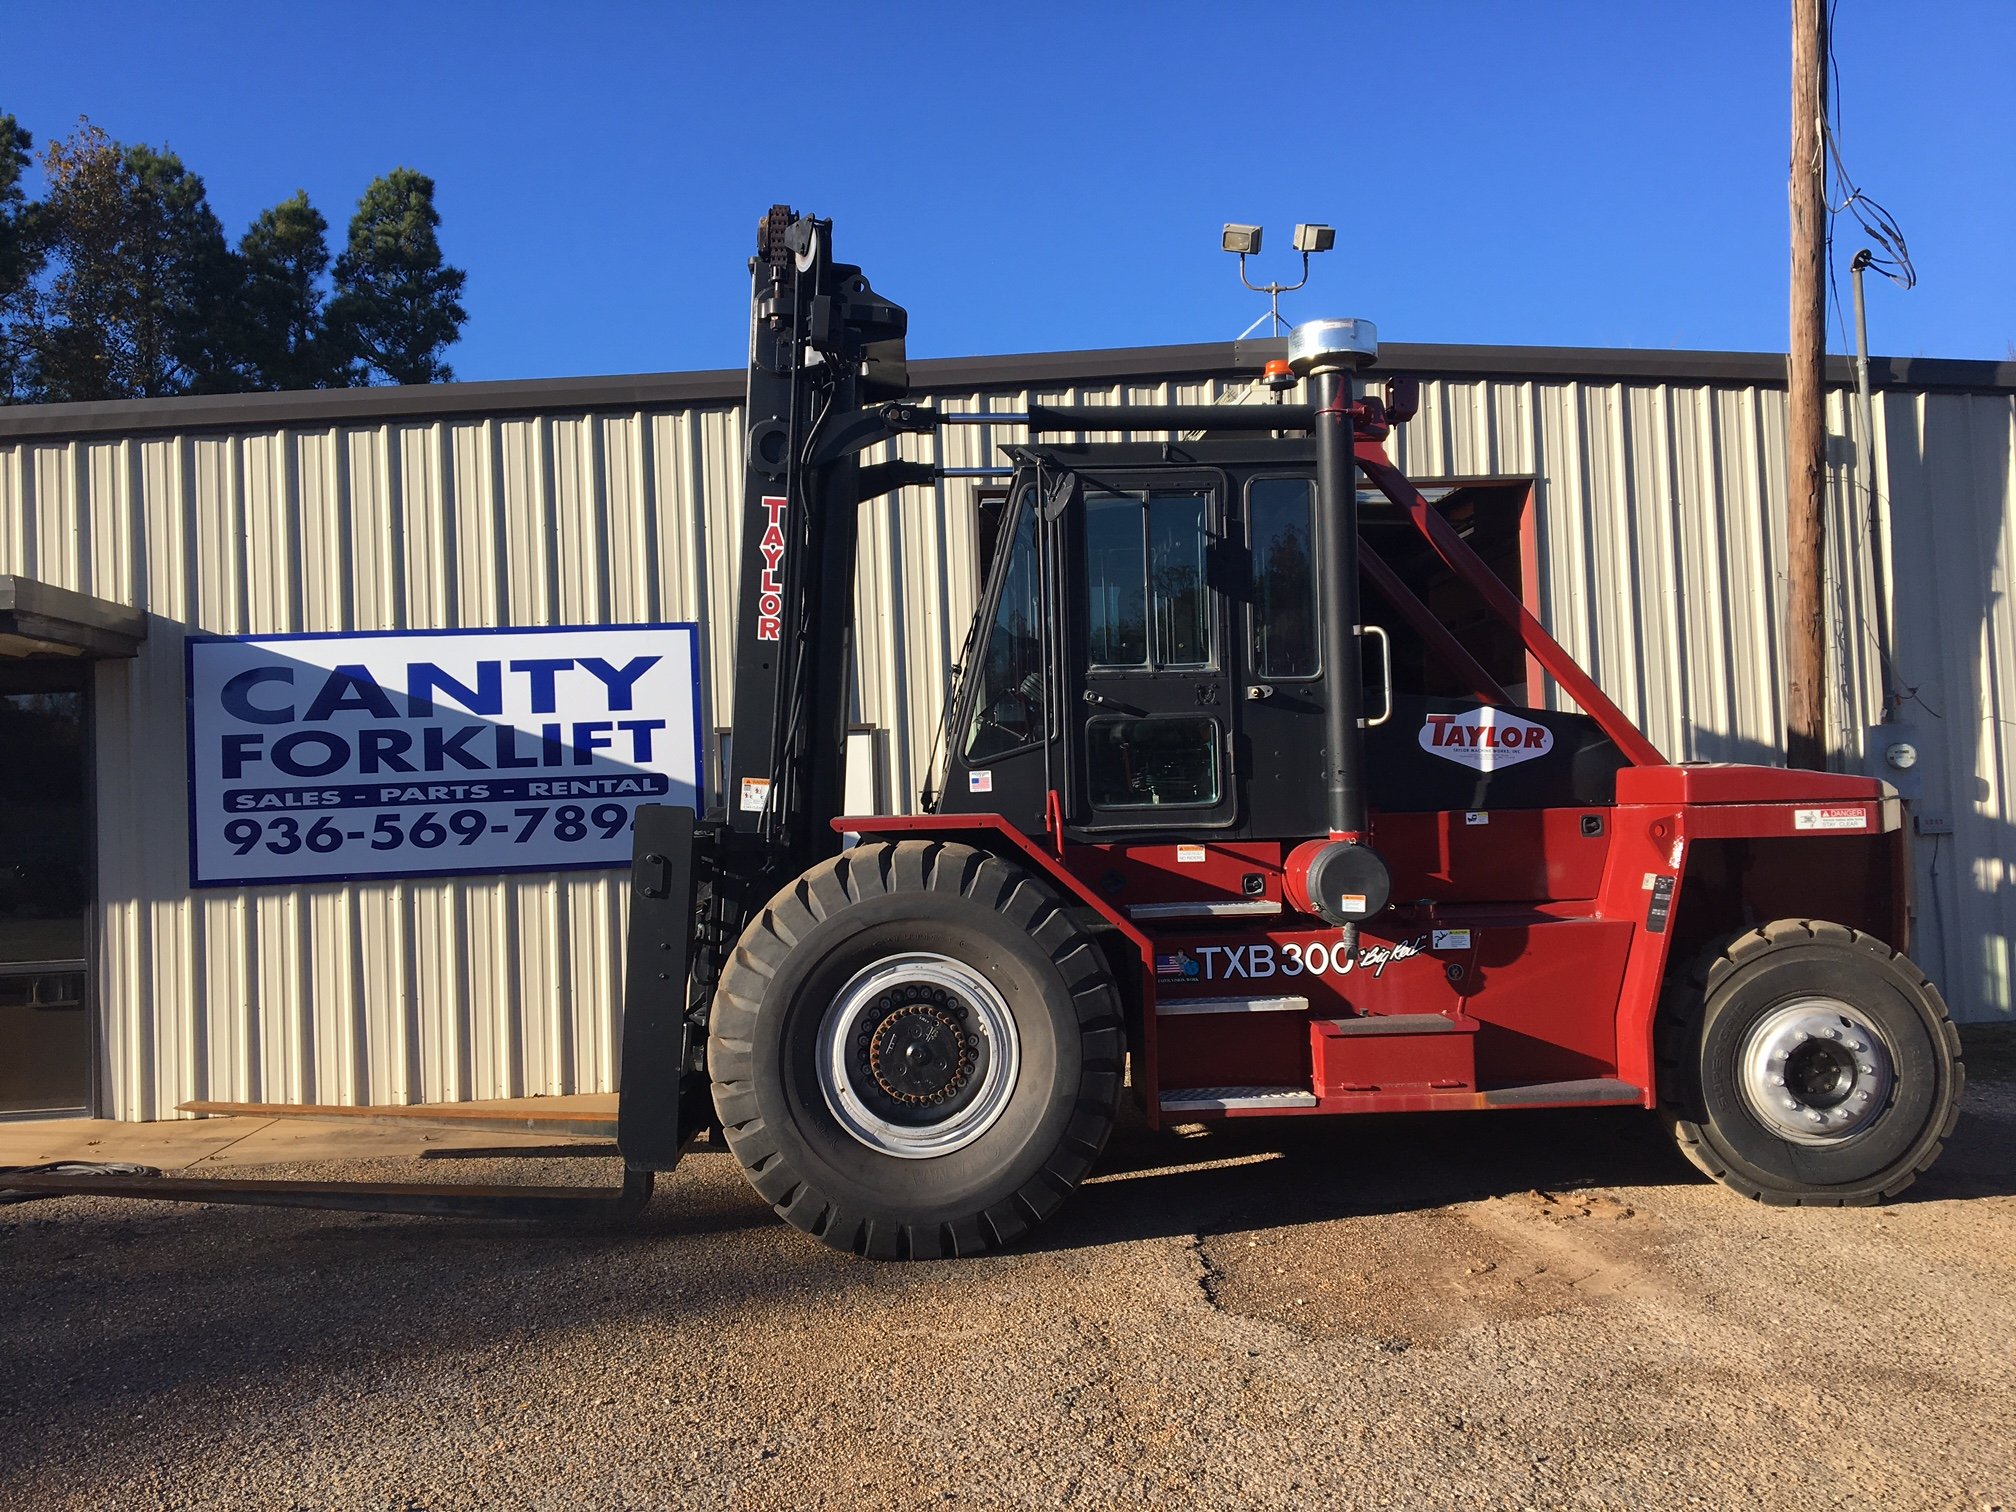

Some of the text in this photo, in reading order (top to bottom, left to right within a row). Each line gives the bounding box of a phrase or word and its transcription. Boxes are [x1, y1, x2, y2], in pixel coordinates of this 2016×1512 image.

[758, 496, 788, 640] TAYLOR
[220, 655, 664, 725] CANTY
[221, 719, 666, 779] FORKLIFT
[1427, 715, 1545, 749] TAYLOR
[235, 790, 342, 809] SALES
[380, 784, 490, 802] PARTS
[528, 777, 660, 797] RENTAL
[1831, 809, 1863, 817] DANGER
[223, 803, 661, 855] 936-569-789
[1196, 944, 1276, 979] TXB
[1281, 942, 1354, 975] 300
